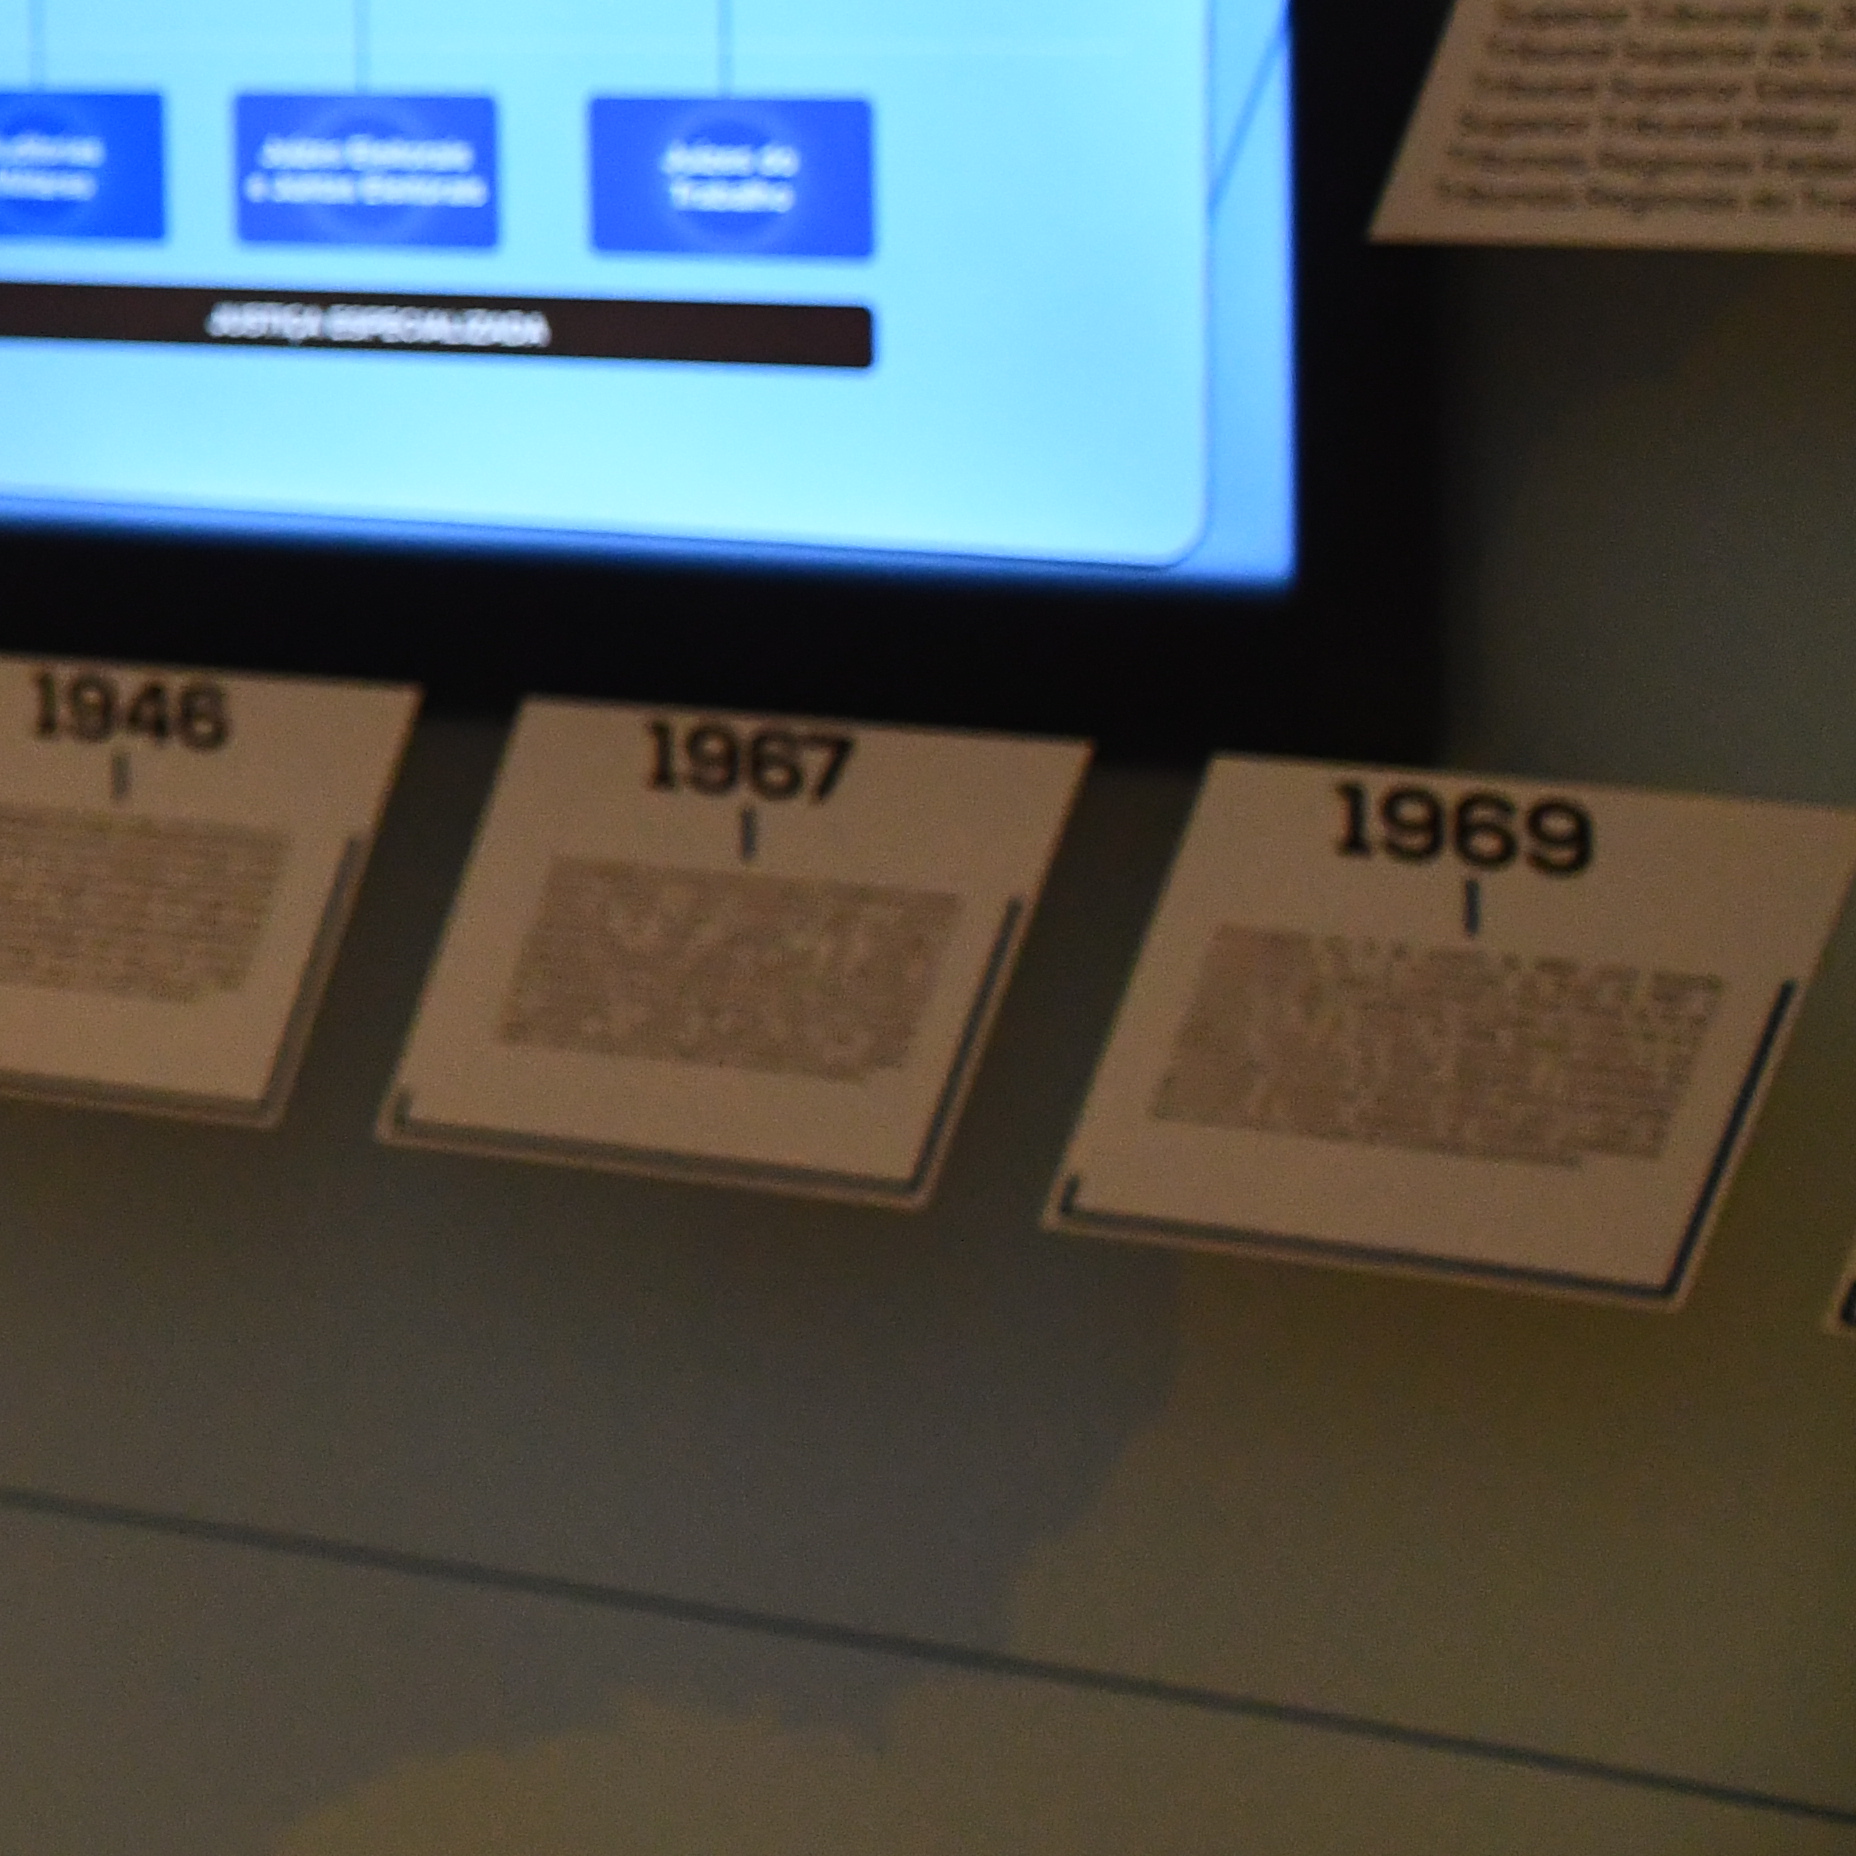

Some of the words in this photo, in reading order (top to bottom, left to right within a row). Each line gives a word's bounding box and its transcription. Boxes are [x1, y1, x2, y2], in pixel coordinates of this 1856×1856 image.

[32, 668, 233, 752] 1946
[648, 719, 856, 804] 1967
[1334, 781, 1594, 874] 1969
